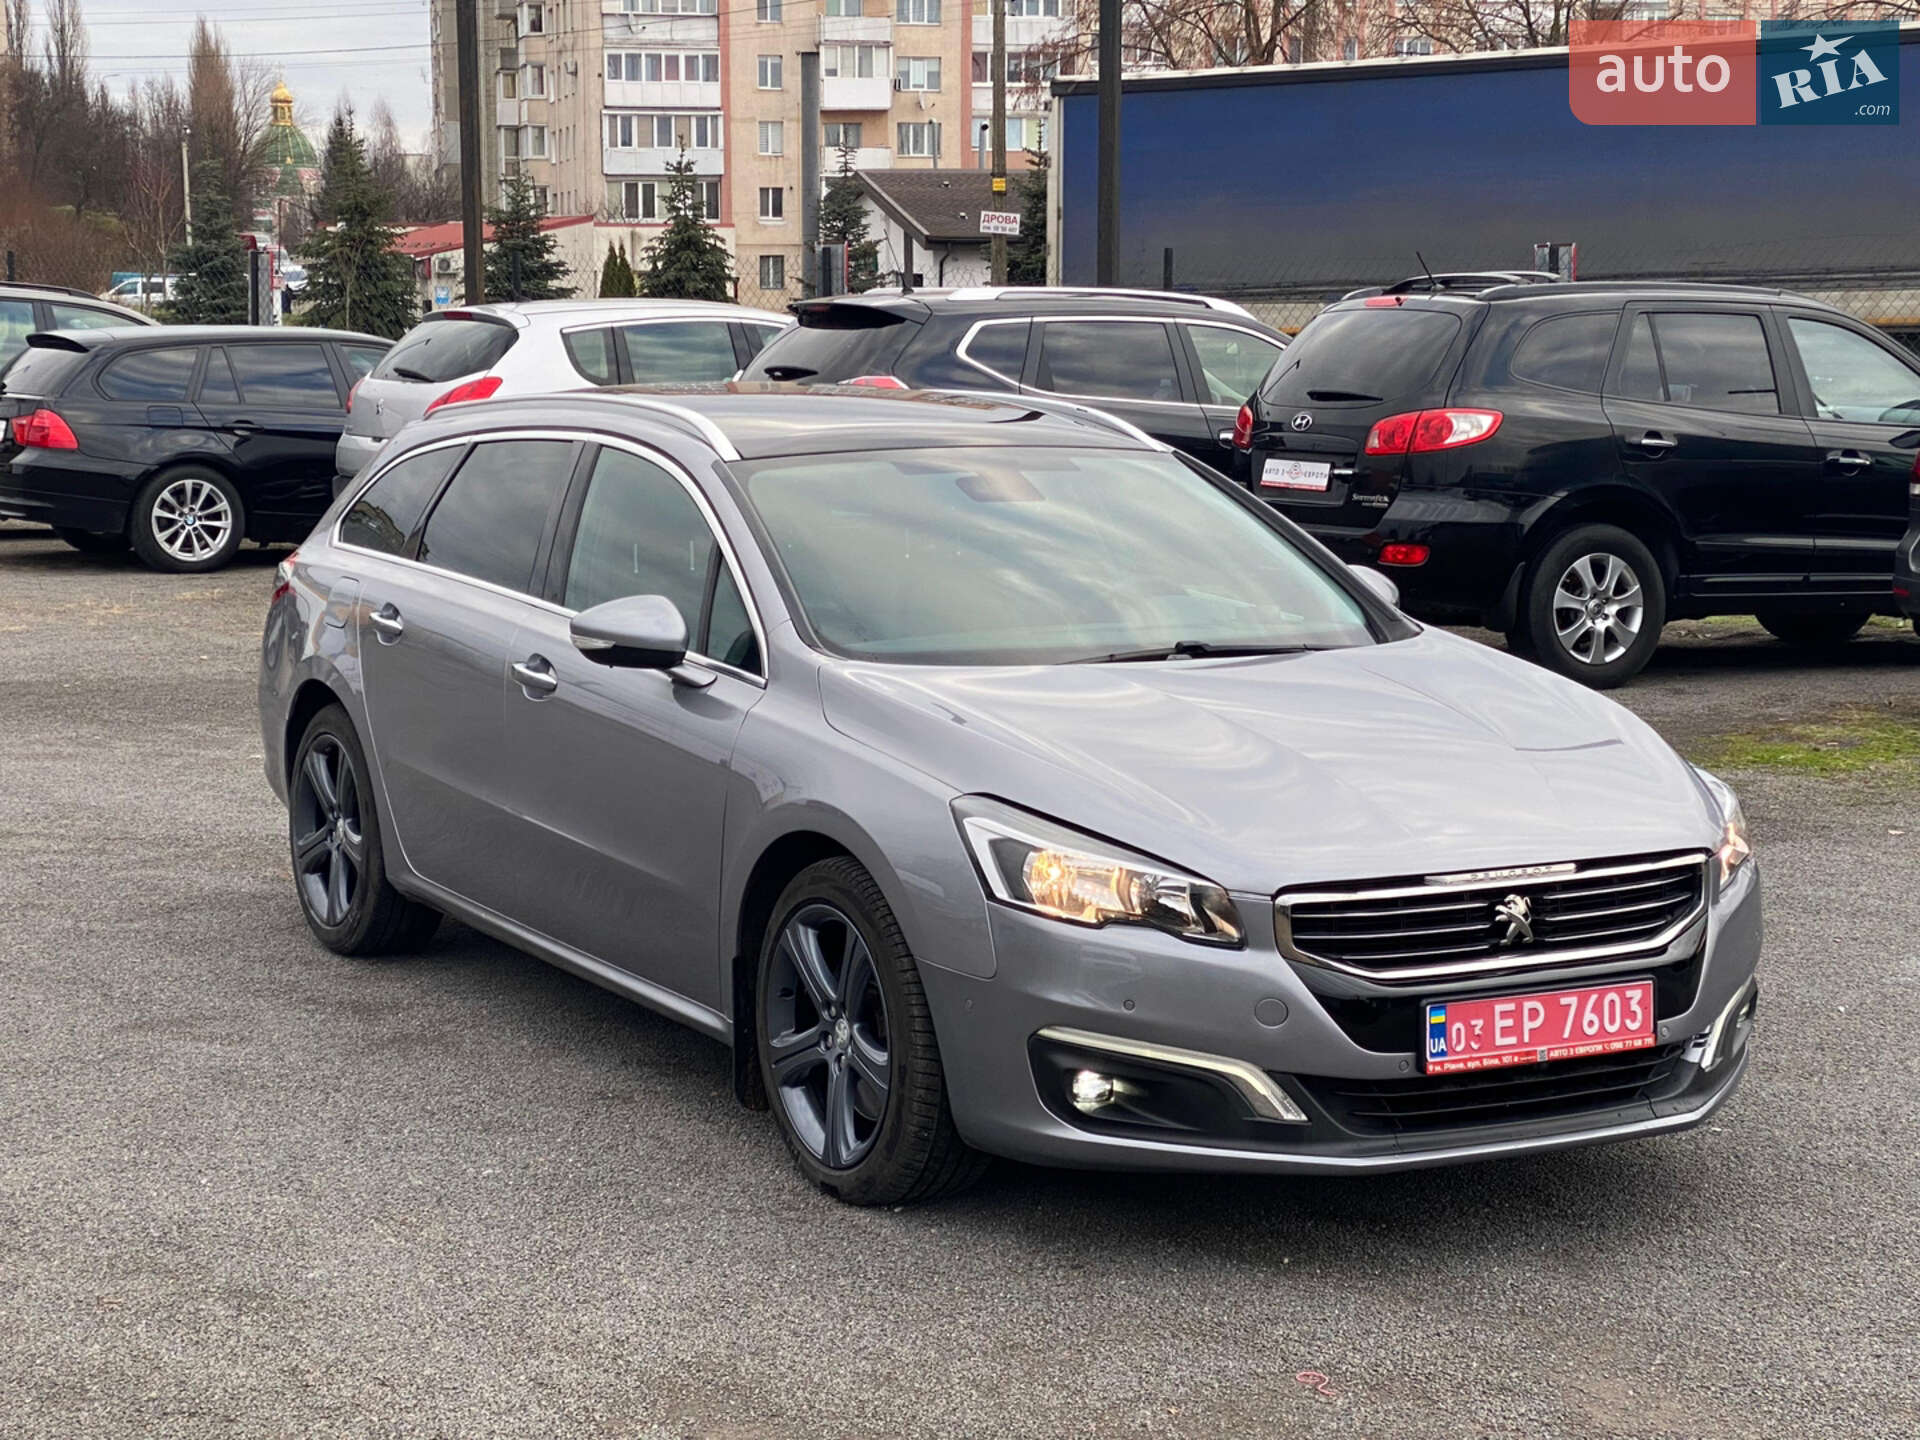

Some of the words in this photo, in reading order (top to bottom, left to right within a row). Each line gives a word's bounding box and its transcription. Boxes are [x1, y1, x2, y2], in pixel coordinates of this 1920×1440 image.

[983, 213, 1018, 225] ДРОВА
[1451, 1019, 1484, 1052] 03
[1494, 1001, 1545, 1047] EP
[1560, 989, 1642, 1039] 7603
[1430, 1037, 1447, 1053] UA
